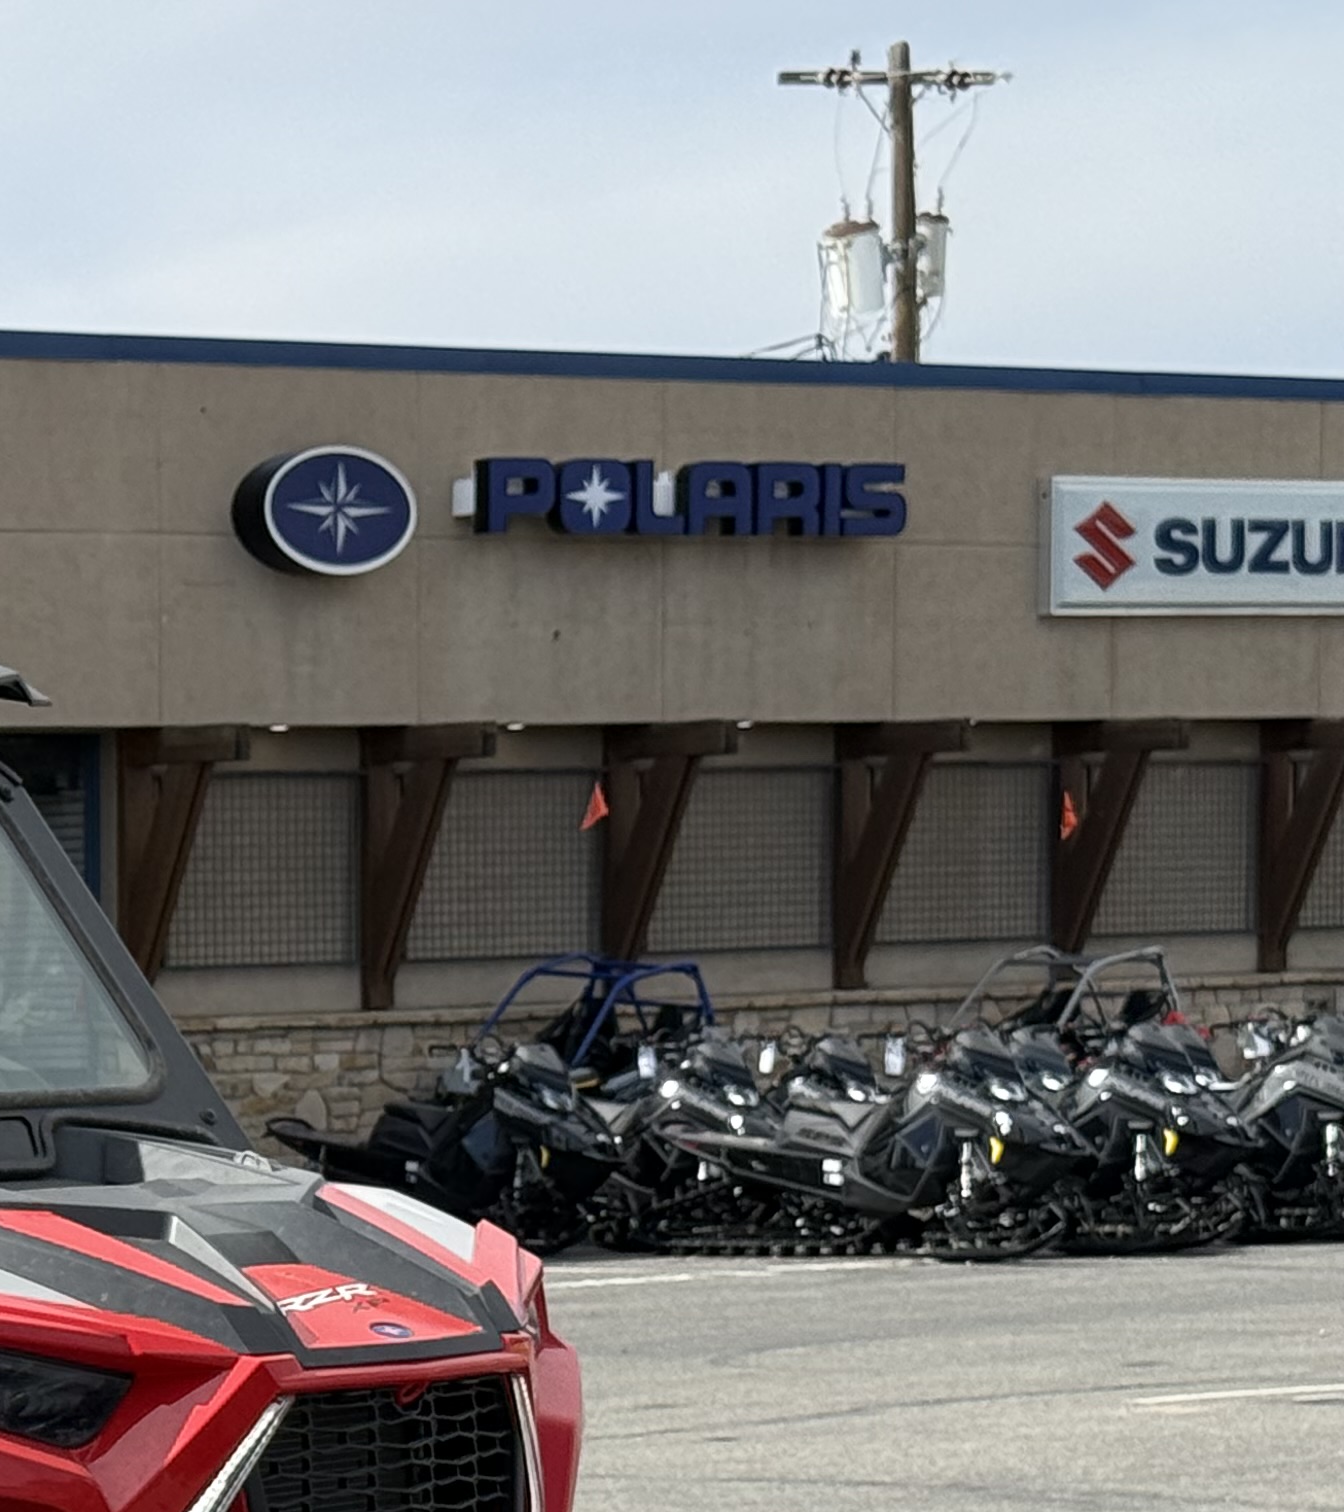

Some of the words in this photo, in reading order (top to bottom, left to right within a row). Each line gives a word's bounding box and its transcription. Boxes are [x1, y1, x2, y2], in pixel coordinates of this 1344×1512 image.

[474, 457, 907, 536] POLARIS
[1153, 517, 1344, 576] SUZU
[275, 1282, 379, 1317] RZR
